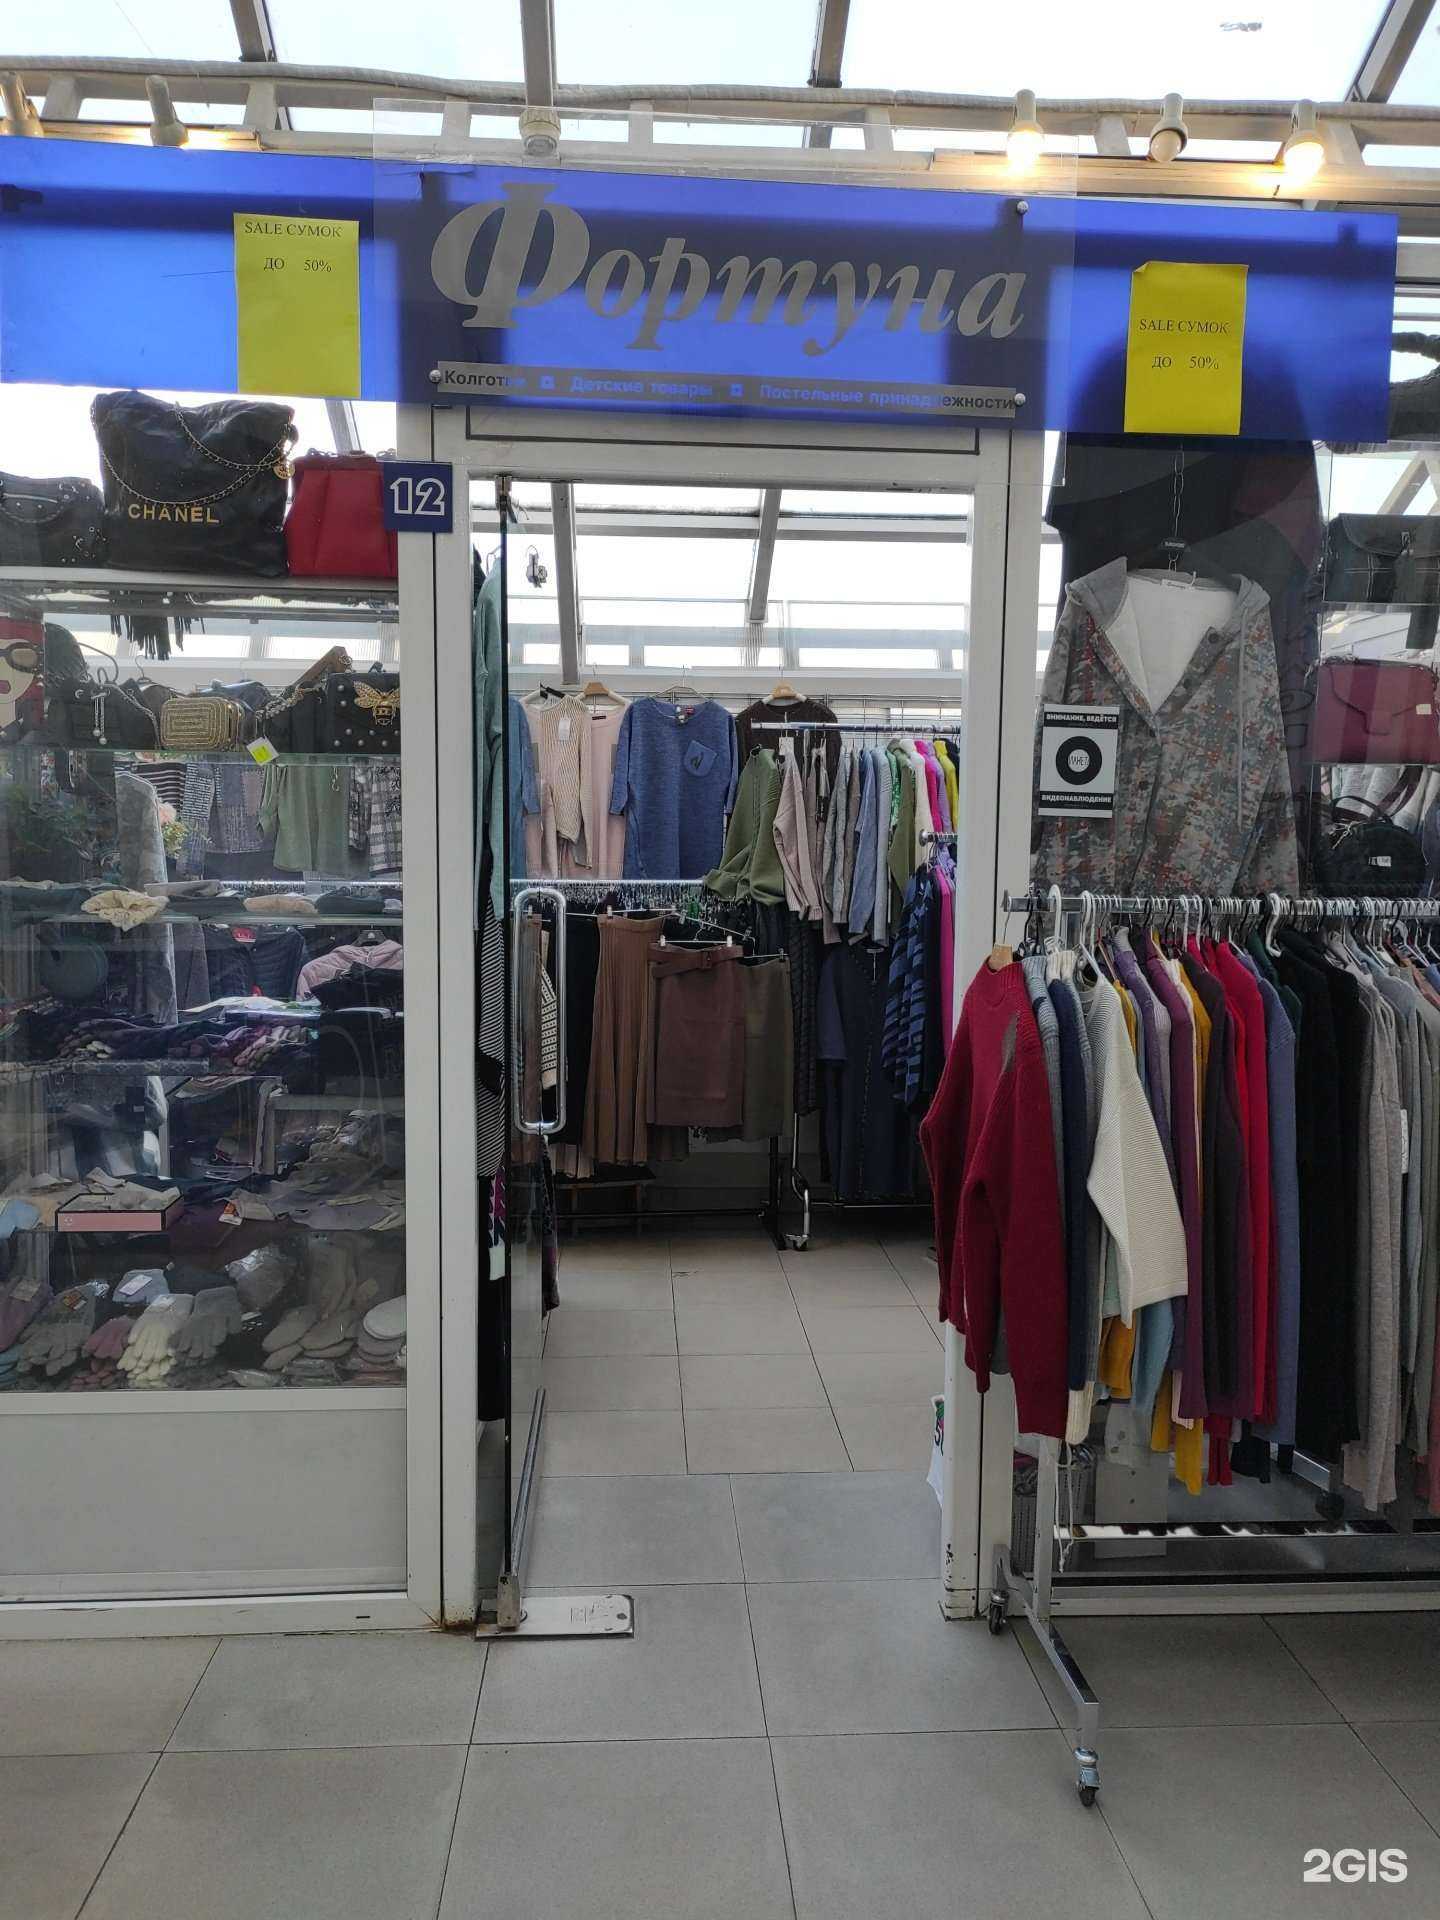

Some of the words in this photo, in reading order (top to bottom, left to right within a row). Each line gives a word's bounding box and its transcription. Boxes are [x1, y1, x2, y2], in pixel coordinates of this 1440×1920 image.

[244, 221, 283, 235] SALE
[286, 223, 343, 238] СУМОК
[263, 257, 286, 272] ДО
[303, 259, 332, 273] 50%
[430, 182, 1026, 357] Фортуна
[1139, 319, 1174, 332] SALE
[1177, 320, 1230, 335] СУМОК
[1151, 356, 1173, 369] ДО
[1188, 356, 1219, 370] 50%
[570, 376, 643, 393] Детские
[760, 384, 864, 403] Постельные
[389, 477, 446, 516] 12
[127, 503, 220, 524] CHANEL
